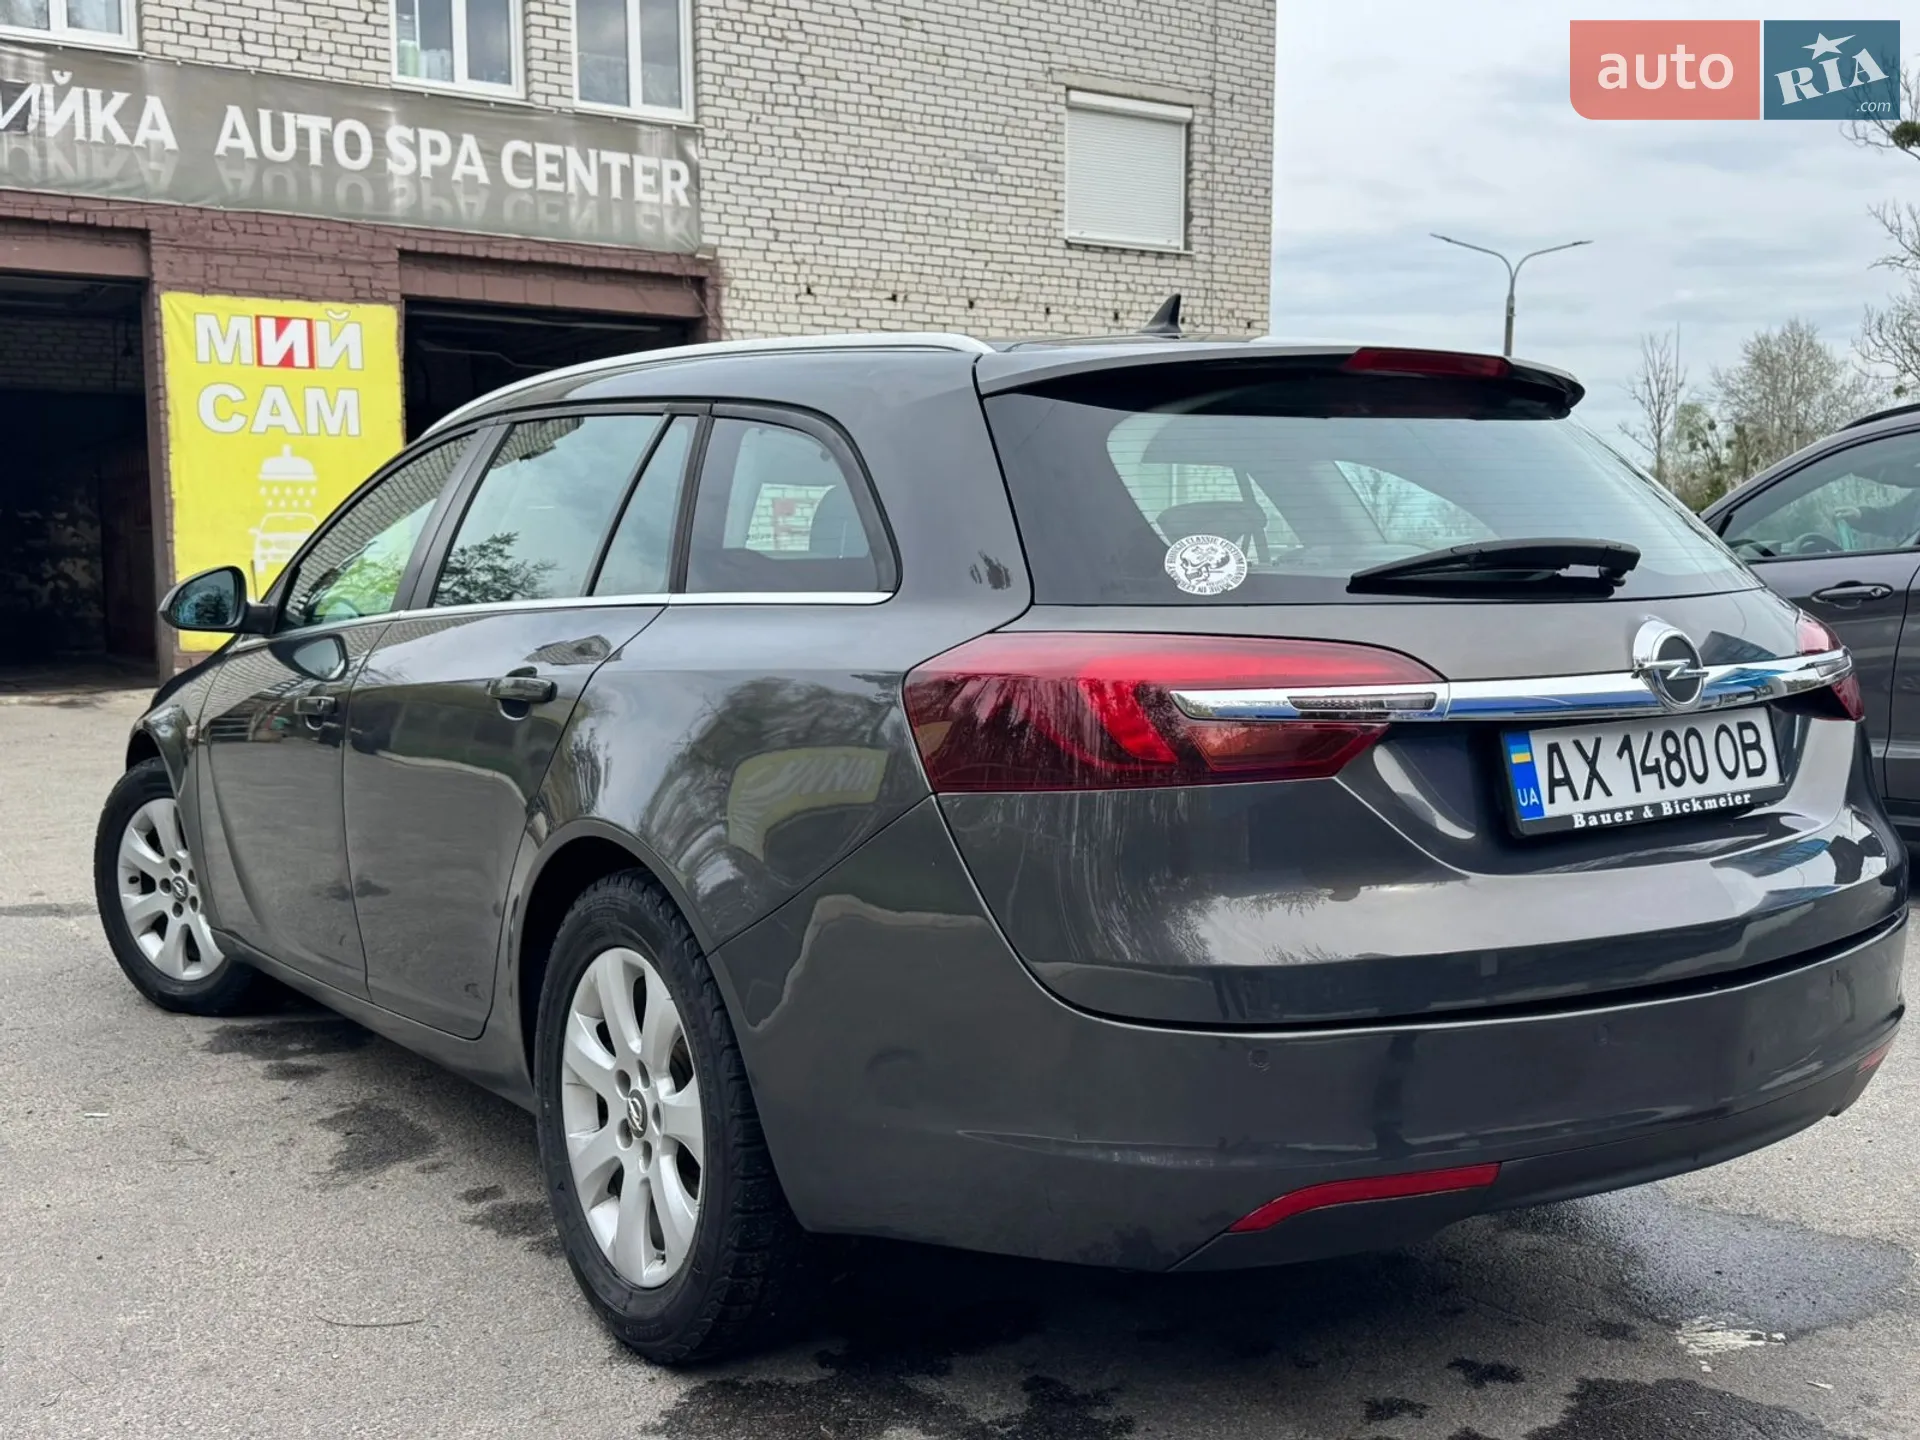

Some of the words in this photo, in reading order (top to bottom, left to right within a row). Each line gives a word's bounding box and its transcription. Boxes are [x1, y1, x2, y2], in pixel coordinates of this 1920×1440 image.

[215, 105, 373, 171] AUTO
[386, 125, 491, 185] SPA
[500, 140, 692, 208] CENTER
[194, 308, 365, 370] МИЙ
[197, 382, 362, 437] САМ
[1547, 737, 1612, 804] AX
[1616, 726, 1708, 793] 1480
[1715, 720, 1768, 781] OB
[1518, 787, 1540, 807] UA
[1573, 811, 1634, 829] Bauer
[1642, 807, 1654, 819] &
[1661, 793, 1752, 816] Bickmeier
